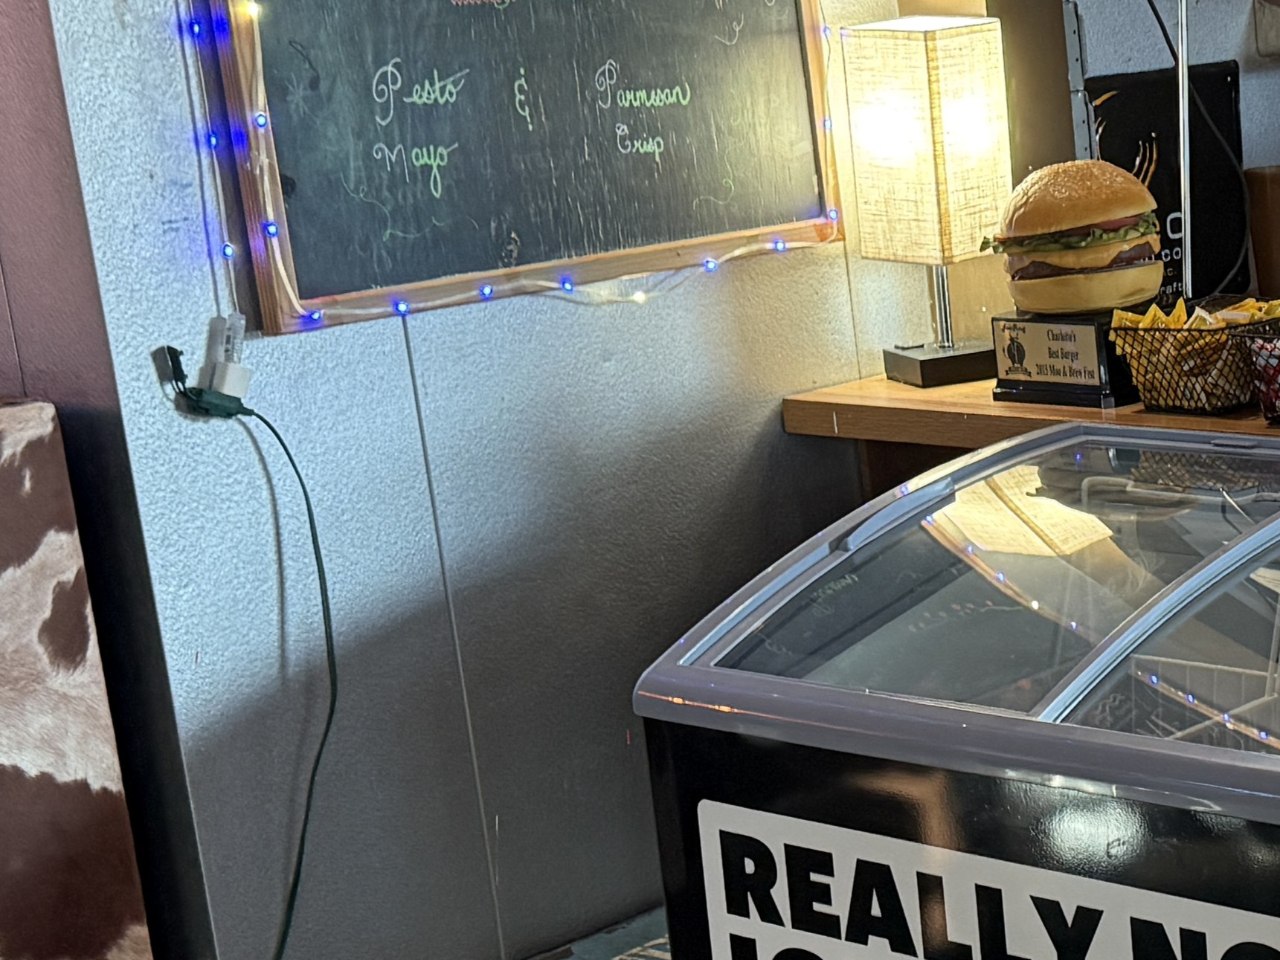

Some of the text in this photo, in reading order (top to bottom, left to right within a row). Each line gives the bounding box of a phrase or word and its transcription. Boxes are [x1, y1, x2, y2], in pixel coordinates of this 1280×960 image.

[373, 57, 470, 127] Pesto
[595, 59, 691, 109] Parmesan
[372, 142, 459, 198] Mayo
[615, 123, 664, 162] Crisp
